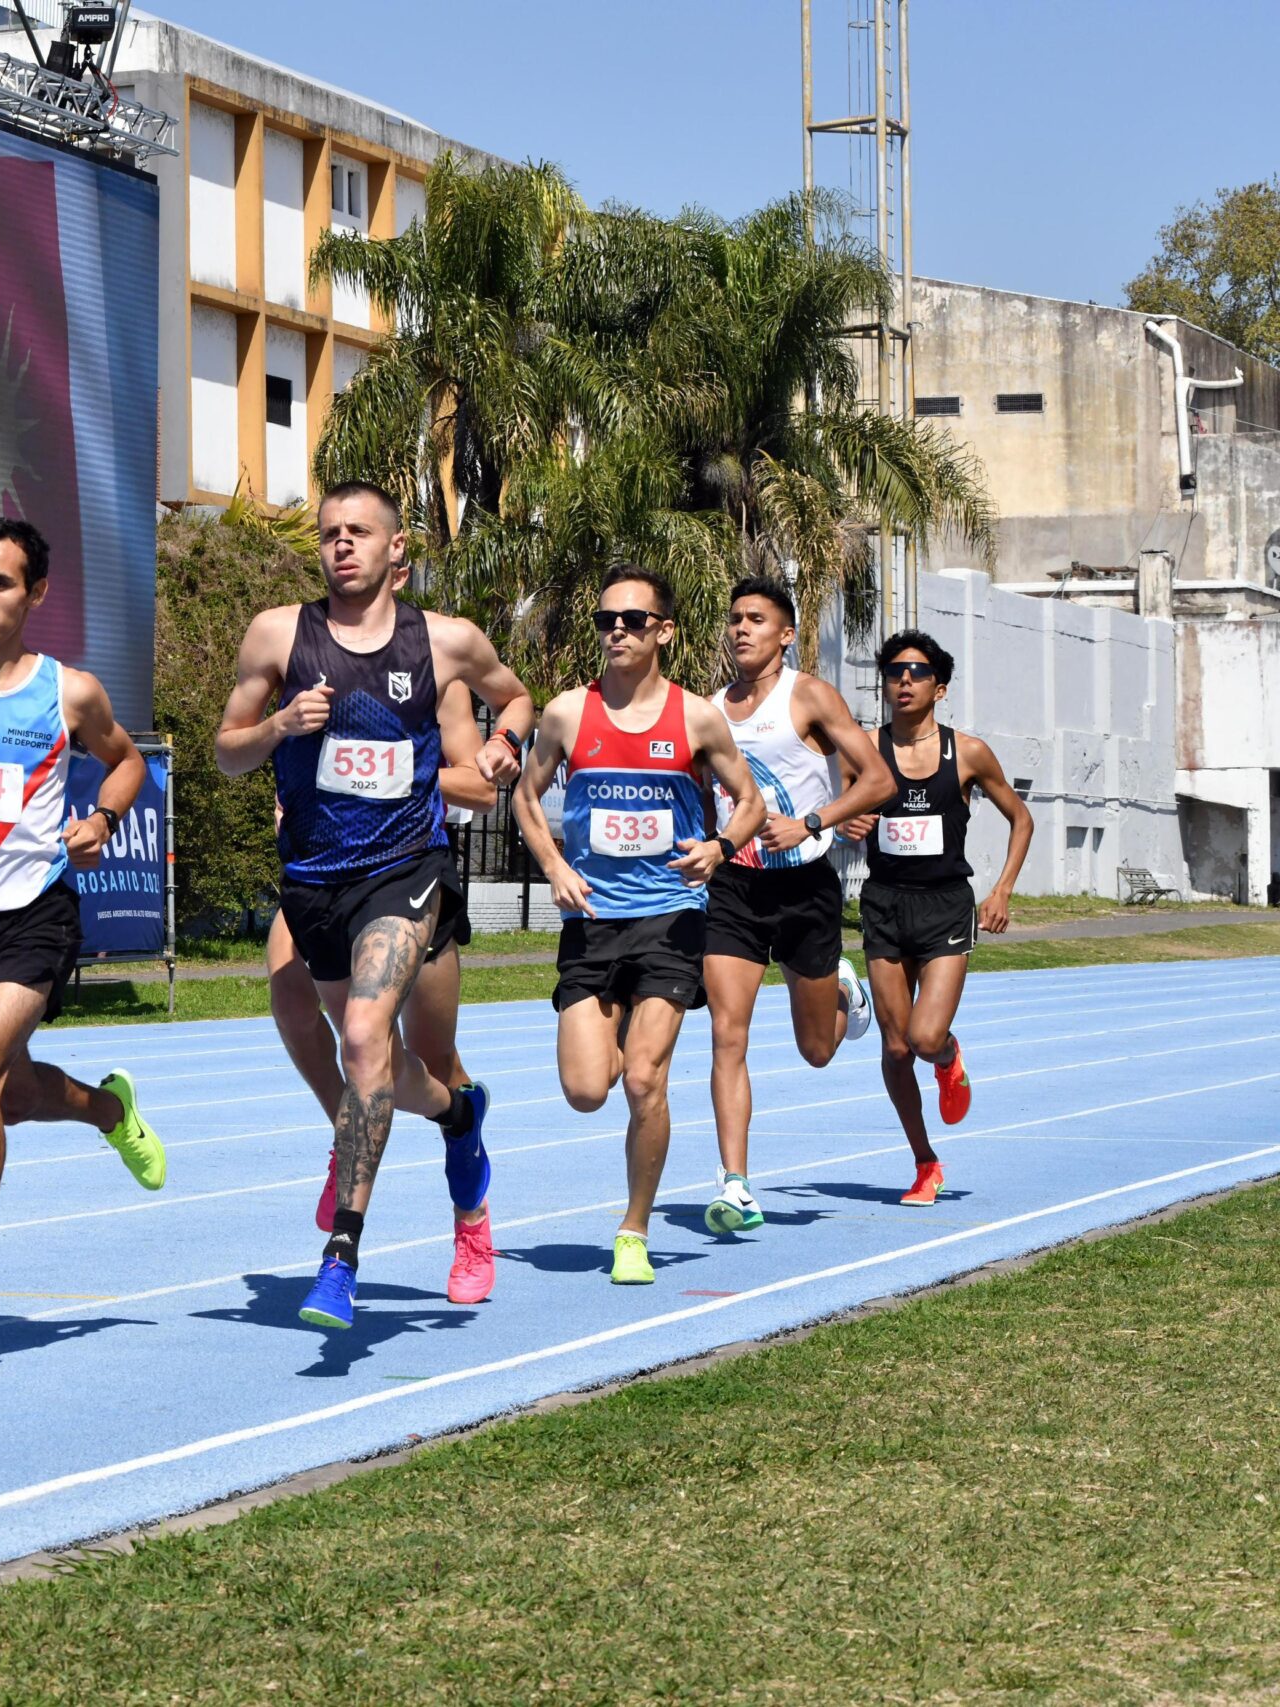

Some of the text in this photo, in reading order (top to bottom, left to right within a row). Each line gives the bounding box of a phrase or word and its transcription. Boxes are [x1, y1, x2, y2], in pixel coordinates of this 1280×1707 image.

[77, 14, 110, 22] AMPRO
[1, 736, 55, 750] DE DEPORTES
[7, 728, 53, 741] MINISTERIO
[333, 747, 395, 777] 531
[350, 780, 378, 790] 2025
[587, 780, 675, 801] CÓRDOBA
[604, 815, 659, 841] 533
[886, 820, 929, 842] 537
[618, 843, 641, 852] 2025
[76, 870, 140, 895] ROSARIO
